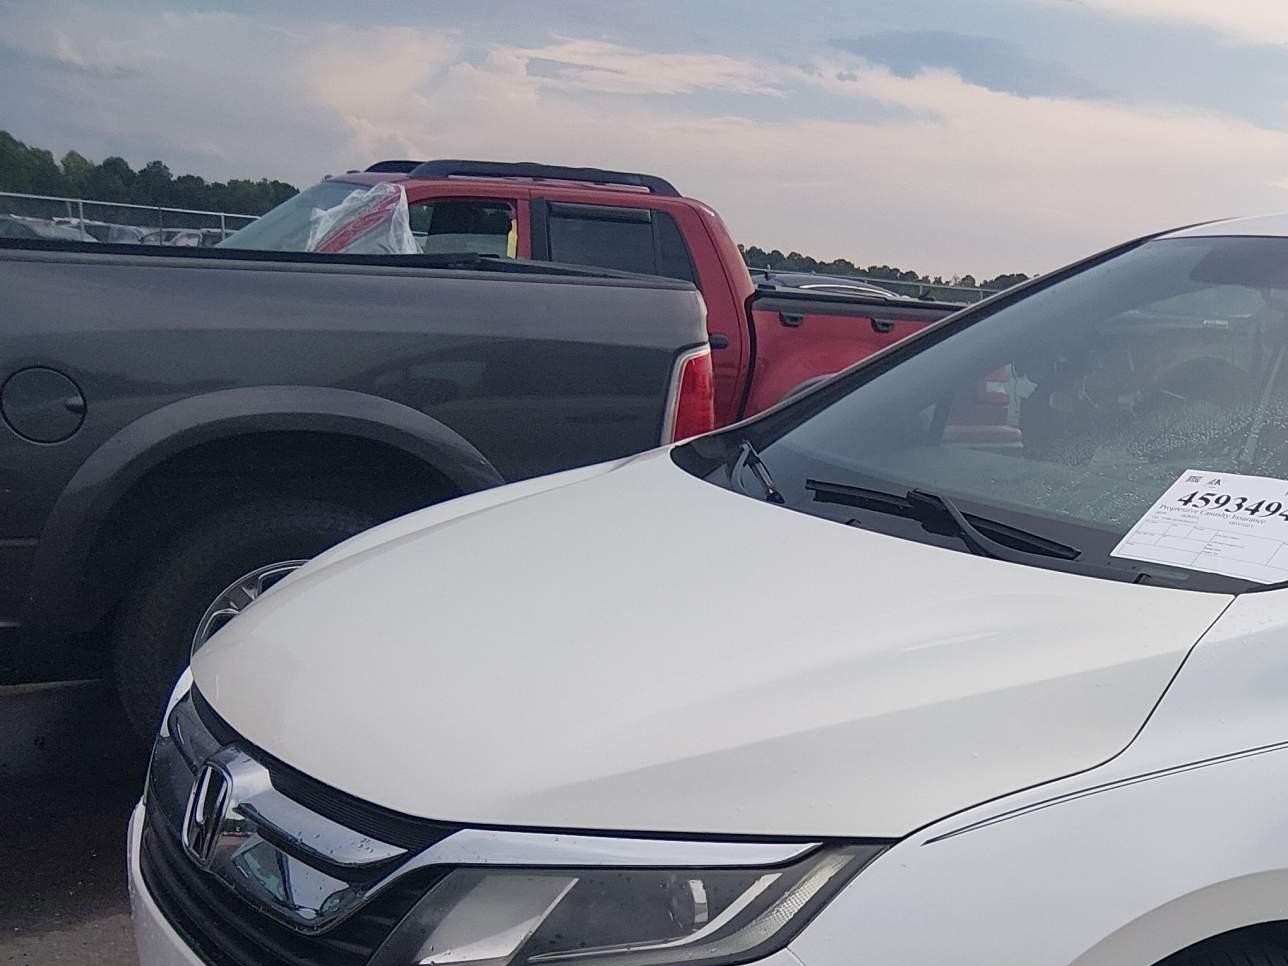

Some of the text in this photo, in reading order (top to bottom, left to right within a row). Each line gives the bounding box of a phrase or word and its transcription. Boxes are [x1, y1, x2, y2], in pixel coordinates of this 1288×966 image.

[1159, 504, 1199, 515] Progressive
[1199, 510, 1229, 520] Casualty
[1231, 514, 1266, 525] Insurance
